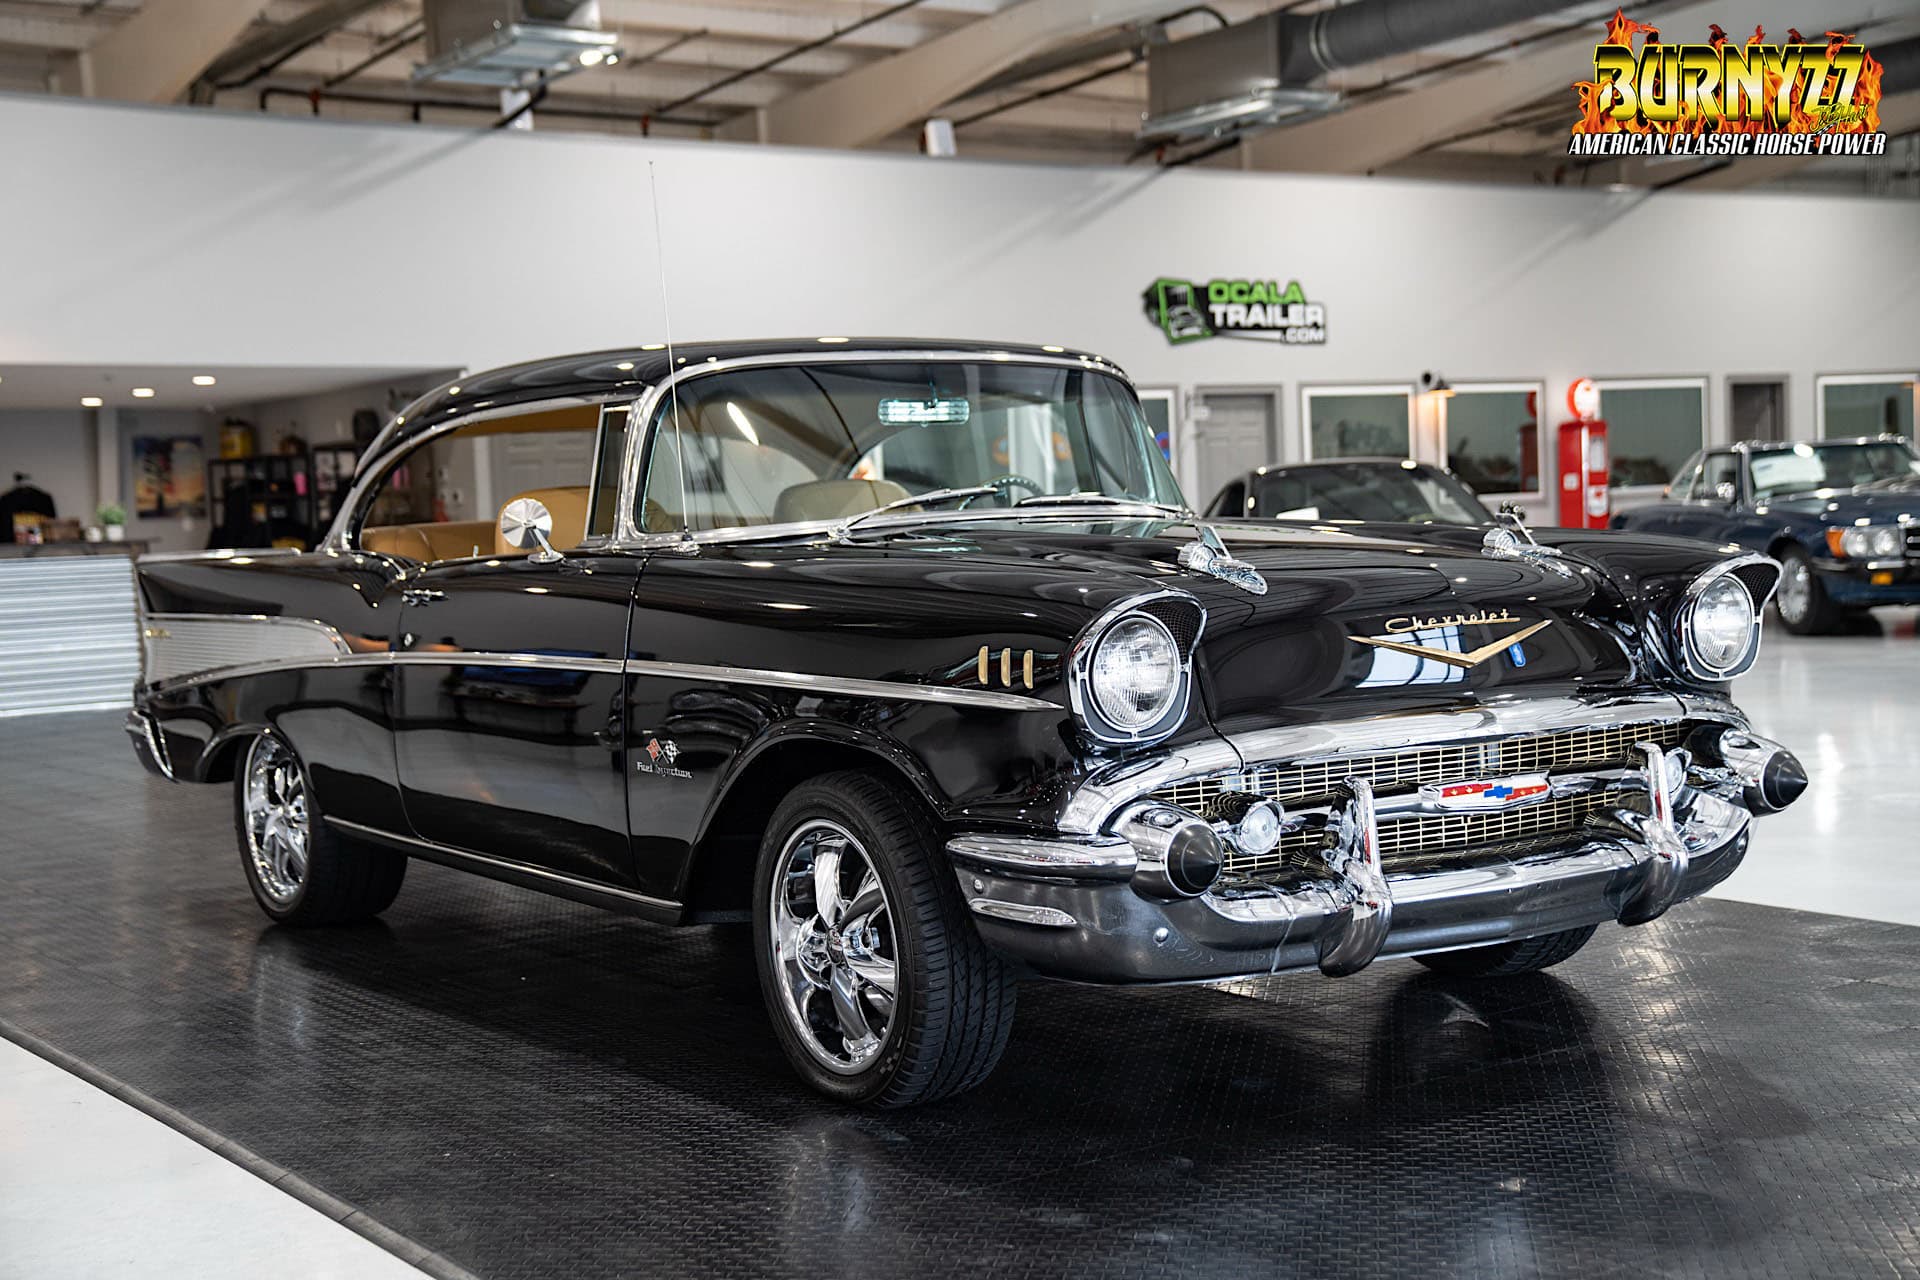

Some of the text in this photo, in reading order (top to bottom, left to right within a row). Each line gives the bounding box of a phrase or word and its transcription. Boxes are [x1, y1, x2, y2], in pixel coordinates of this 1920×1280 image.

[1208, 279, 1305, 304] OCALA
[1209, 303, 1325, 328] TRAILER
[1281, 327, 1325, 344] .COM
[1384, 608, 1520, 633] Chevrolet
